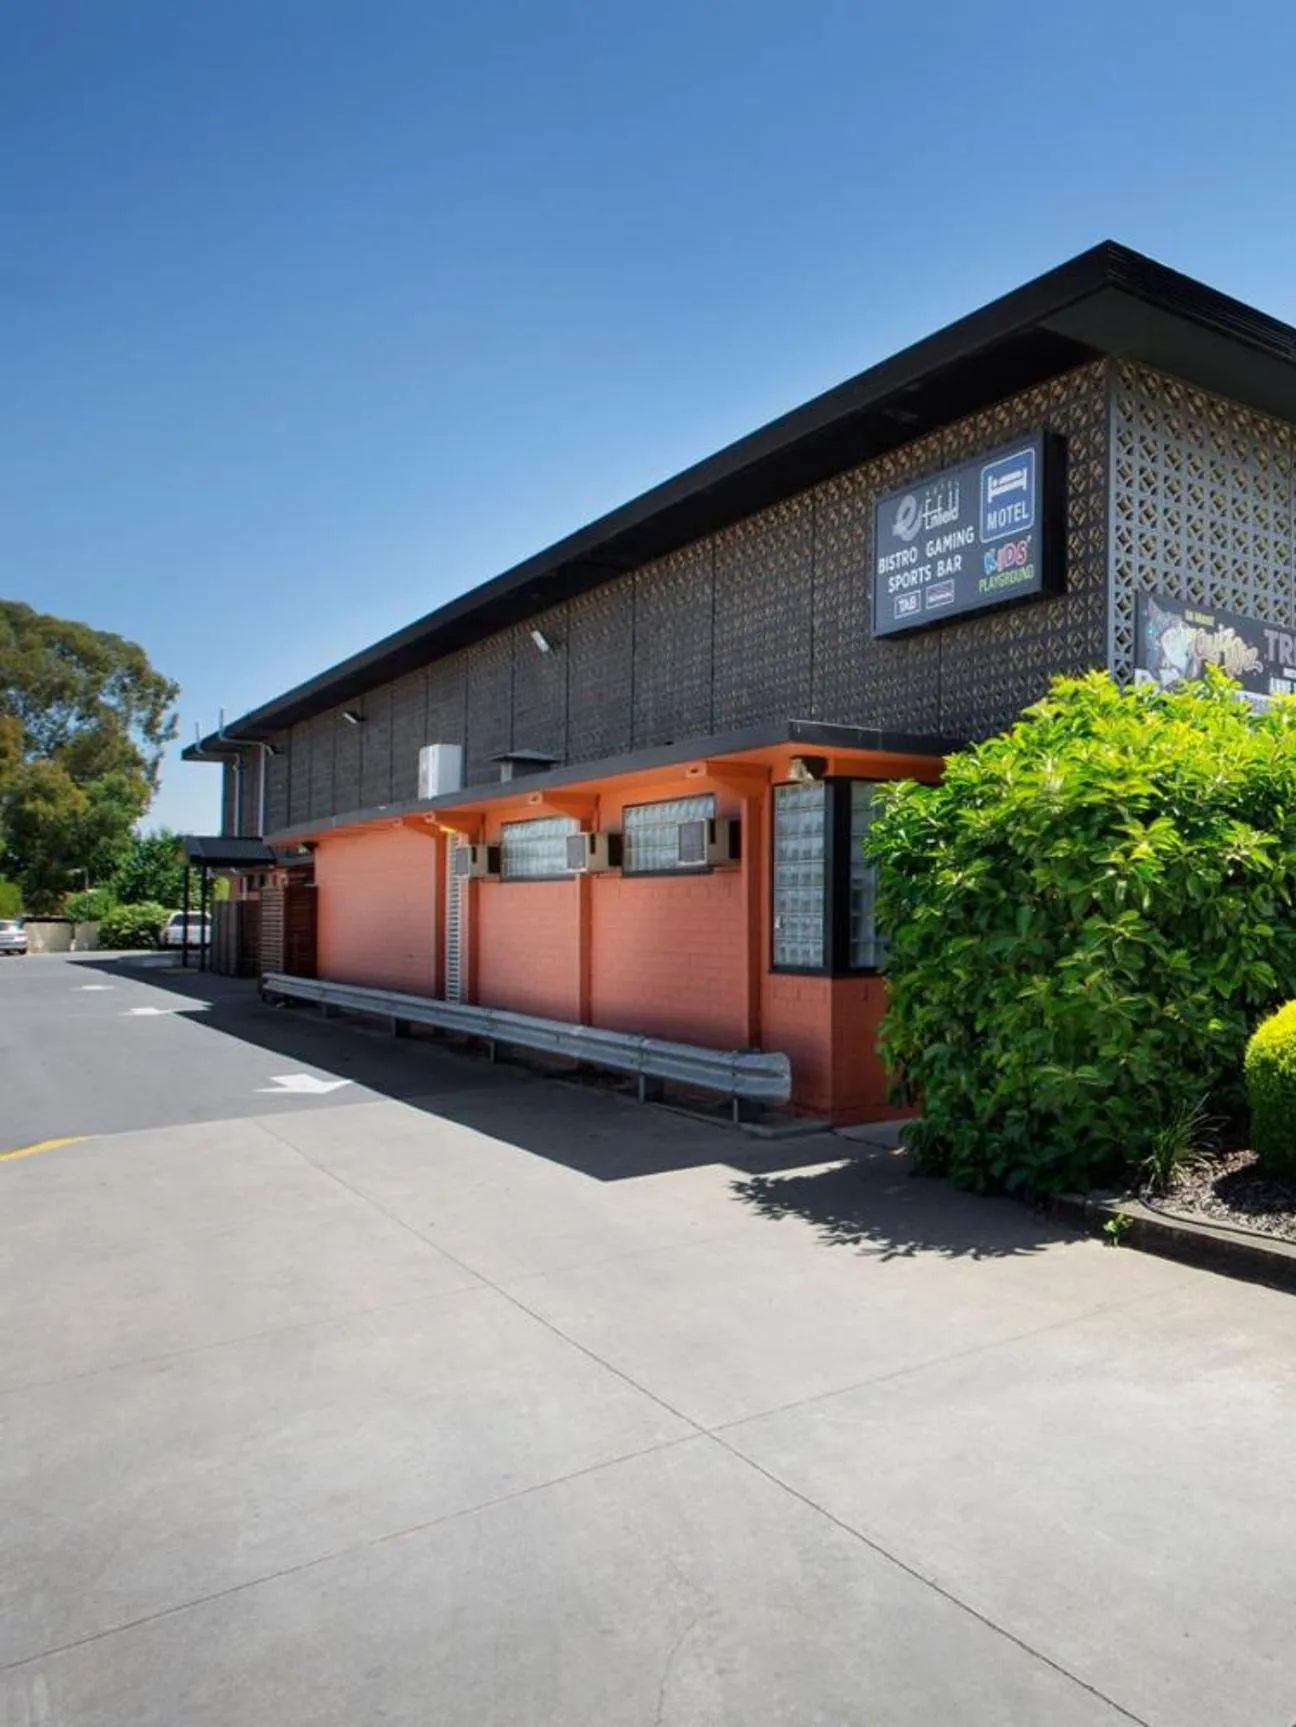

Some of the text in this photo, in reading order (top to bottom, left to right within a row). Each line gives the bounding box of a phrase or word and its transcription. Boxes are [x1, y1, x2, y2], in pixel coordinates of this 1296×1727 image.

[986, 501, 1029, 532] MOTEL
[878, 526, 975, 574] BISTRO GAMING
[887, 555, 962, 593] SPORTS BAR
[978, 564, 1035, 592] PLAYGROUND
